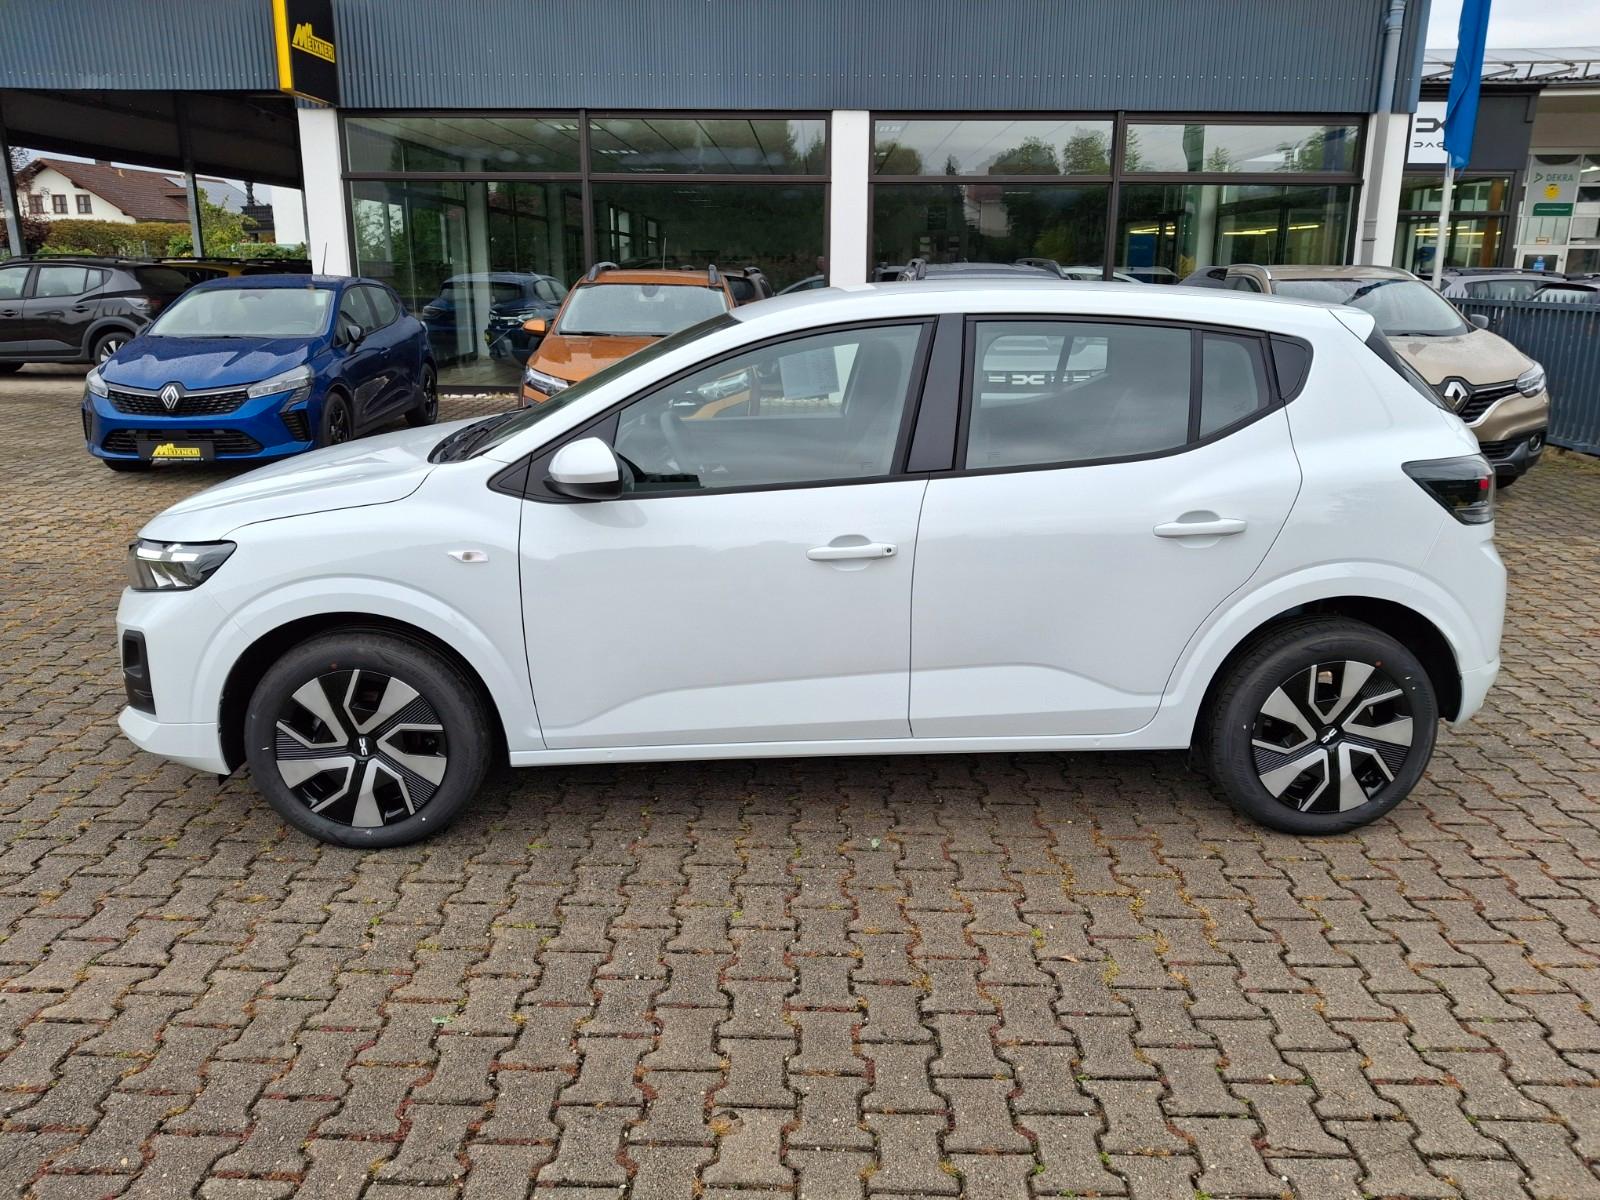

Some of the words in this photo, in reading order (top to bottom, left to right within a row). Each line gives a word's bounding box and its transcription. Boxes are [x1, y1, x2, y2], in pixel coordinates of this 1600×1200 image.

[292, 22, 334, 62] MEIXNER
[1546, 173, 1574, 182] DEKRA
[152, 443, 200, 457] MEIXNER
